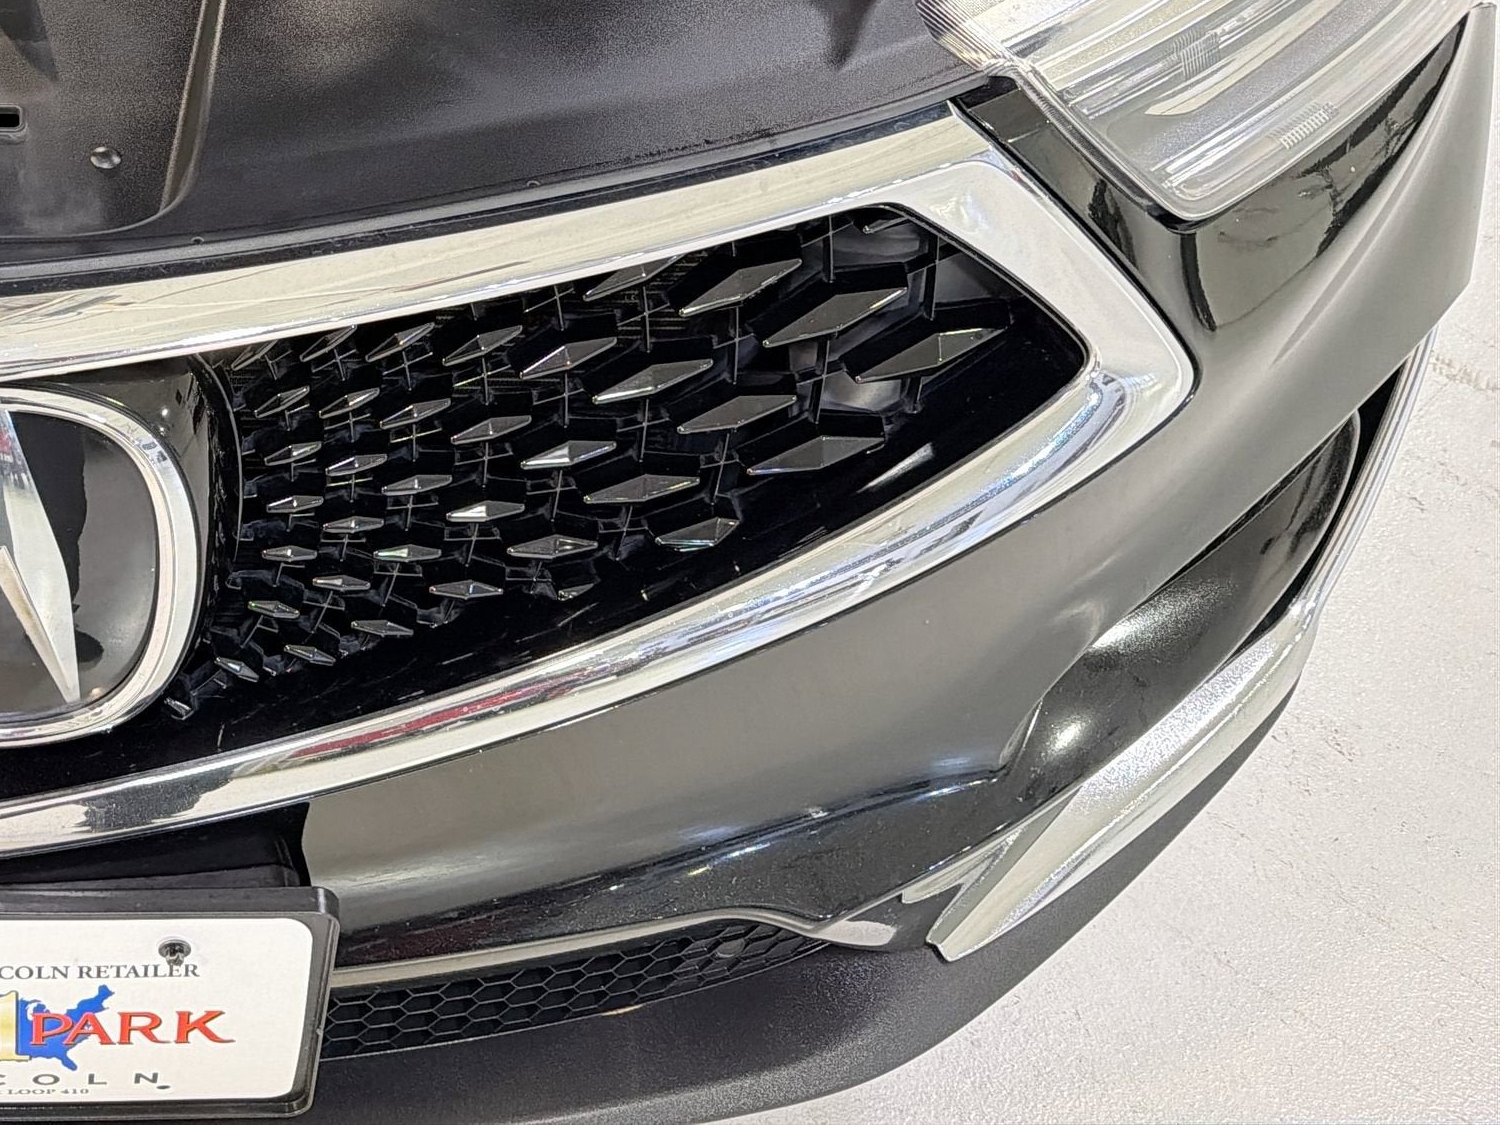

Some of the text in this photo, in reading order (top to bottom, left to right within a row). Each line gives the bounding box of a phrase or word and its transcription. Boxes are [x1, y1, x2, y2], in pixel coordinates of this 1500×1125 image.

[77, 963, 200, 979] RETAILER
[31, 1010, 236, 1046] PARK
[8, 1088, 56, 1096] LOOP
[60, 1087, 90, 1095] 410
